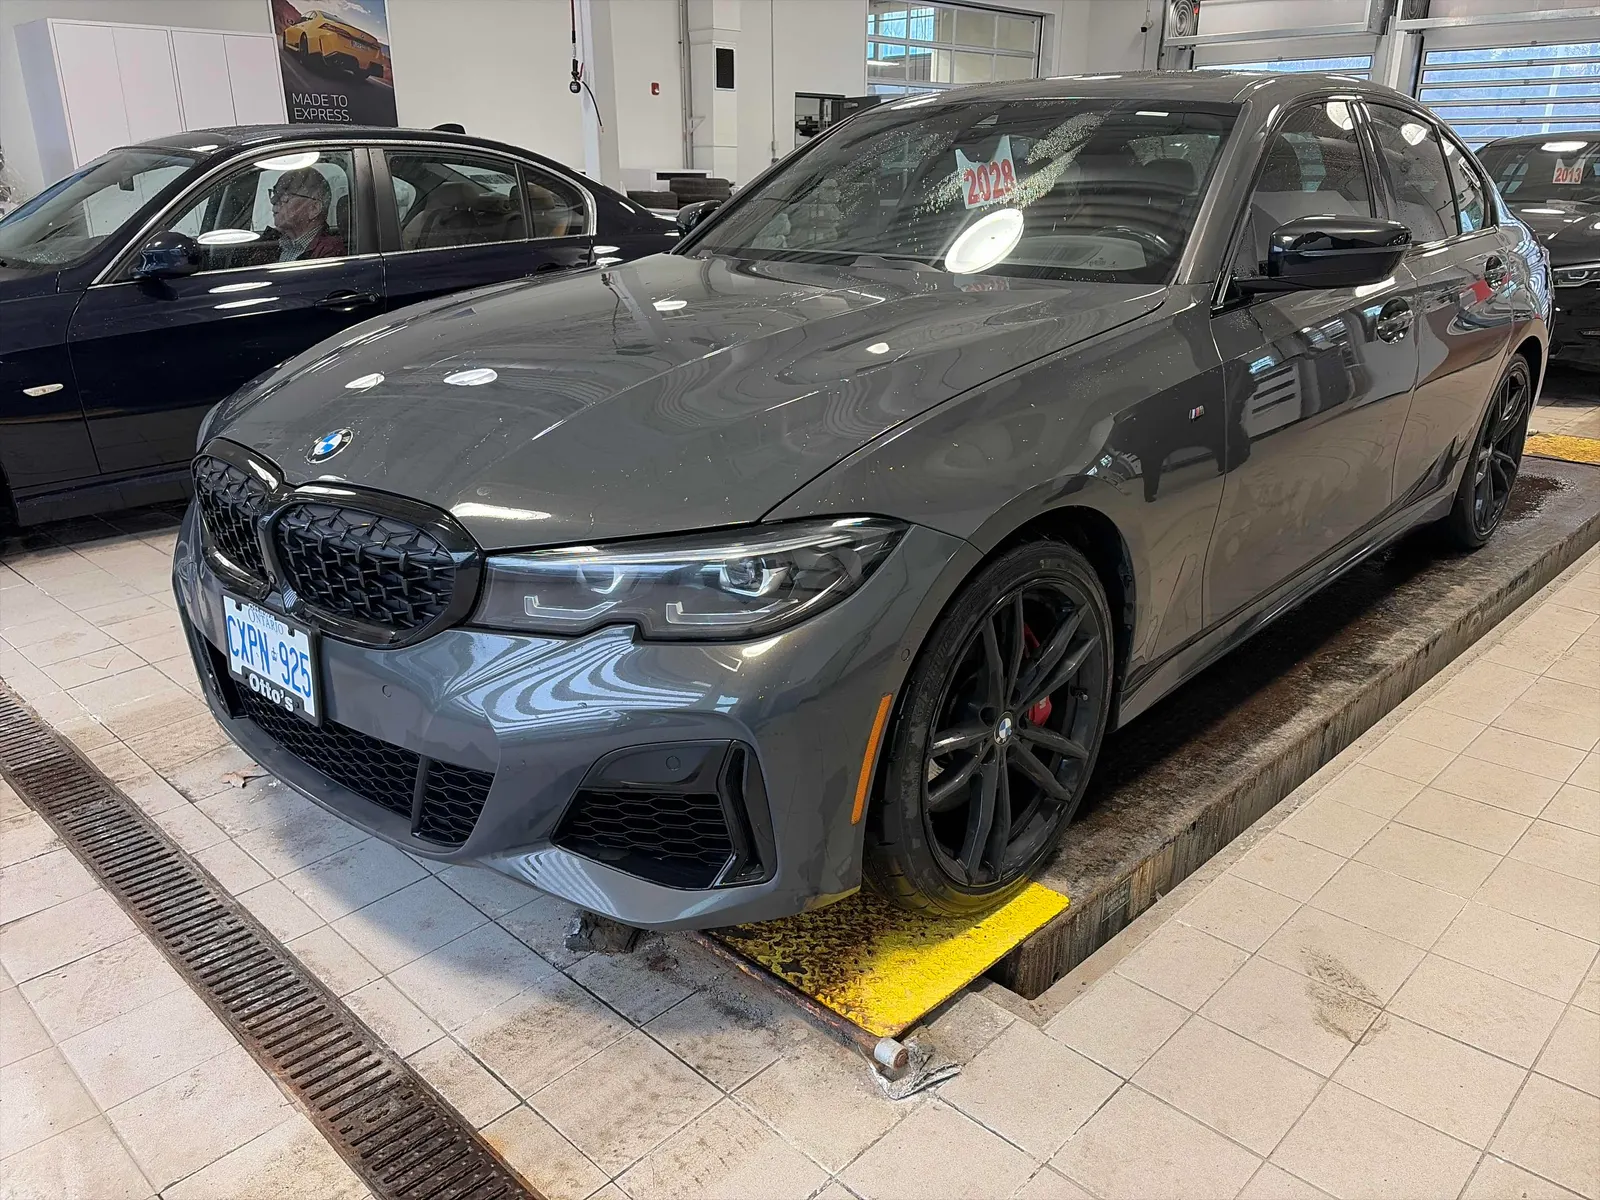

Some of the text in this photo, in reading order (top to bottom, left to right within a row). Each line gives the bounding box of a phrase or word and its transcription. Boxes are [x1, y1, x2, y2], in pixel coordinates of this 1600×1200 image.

[292, 93, 348, 107] MADE TO
[294, 108, 353, 121] EXPRESS.
[963, 159, 1015, 205] 2028
[1555, 168, 1582, 182] 2013
[248, 608, 284, 635] ONTARIO
[227, 615, 311, 698] CXPN 925
[249, 673, 294, 712] Otto's
